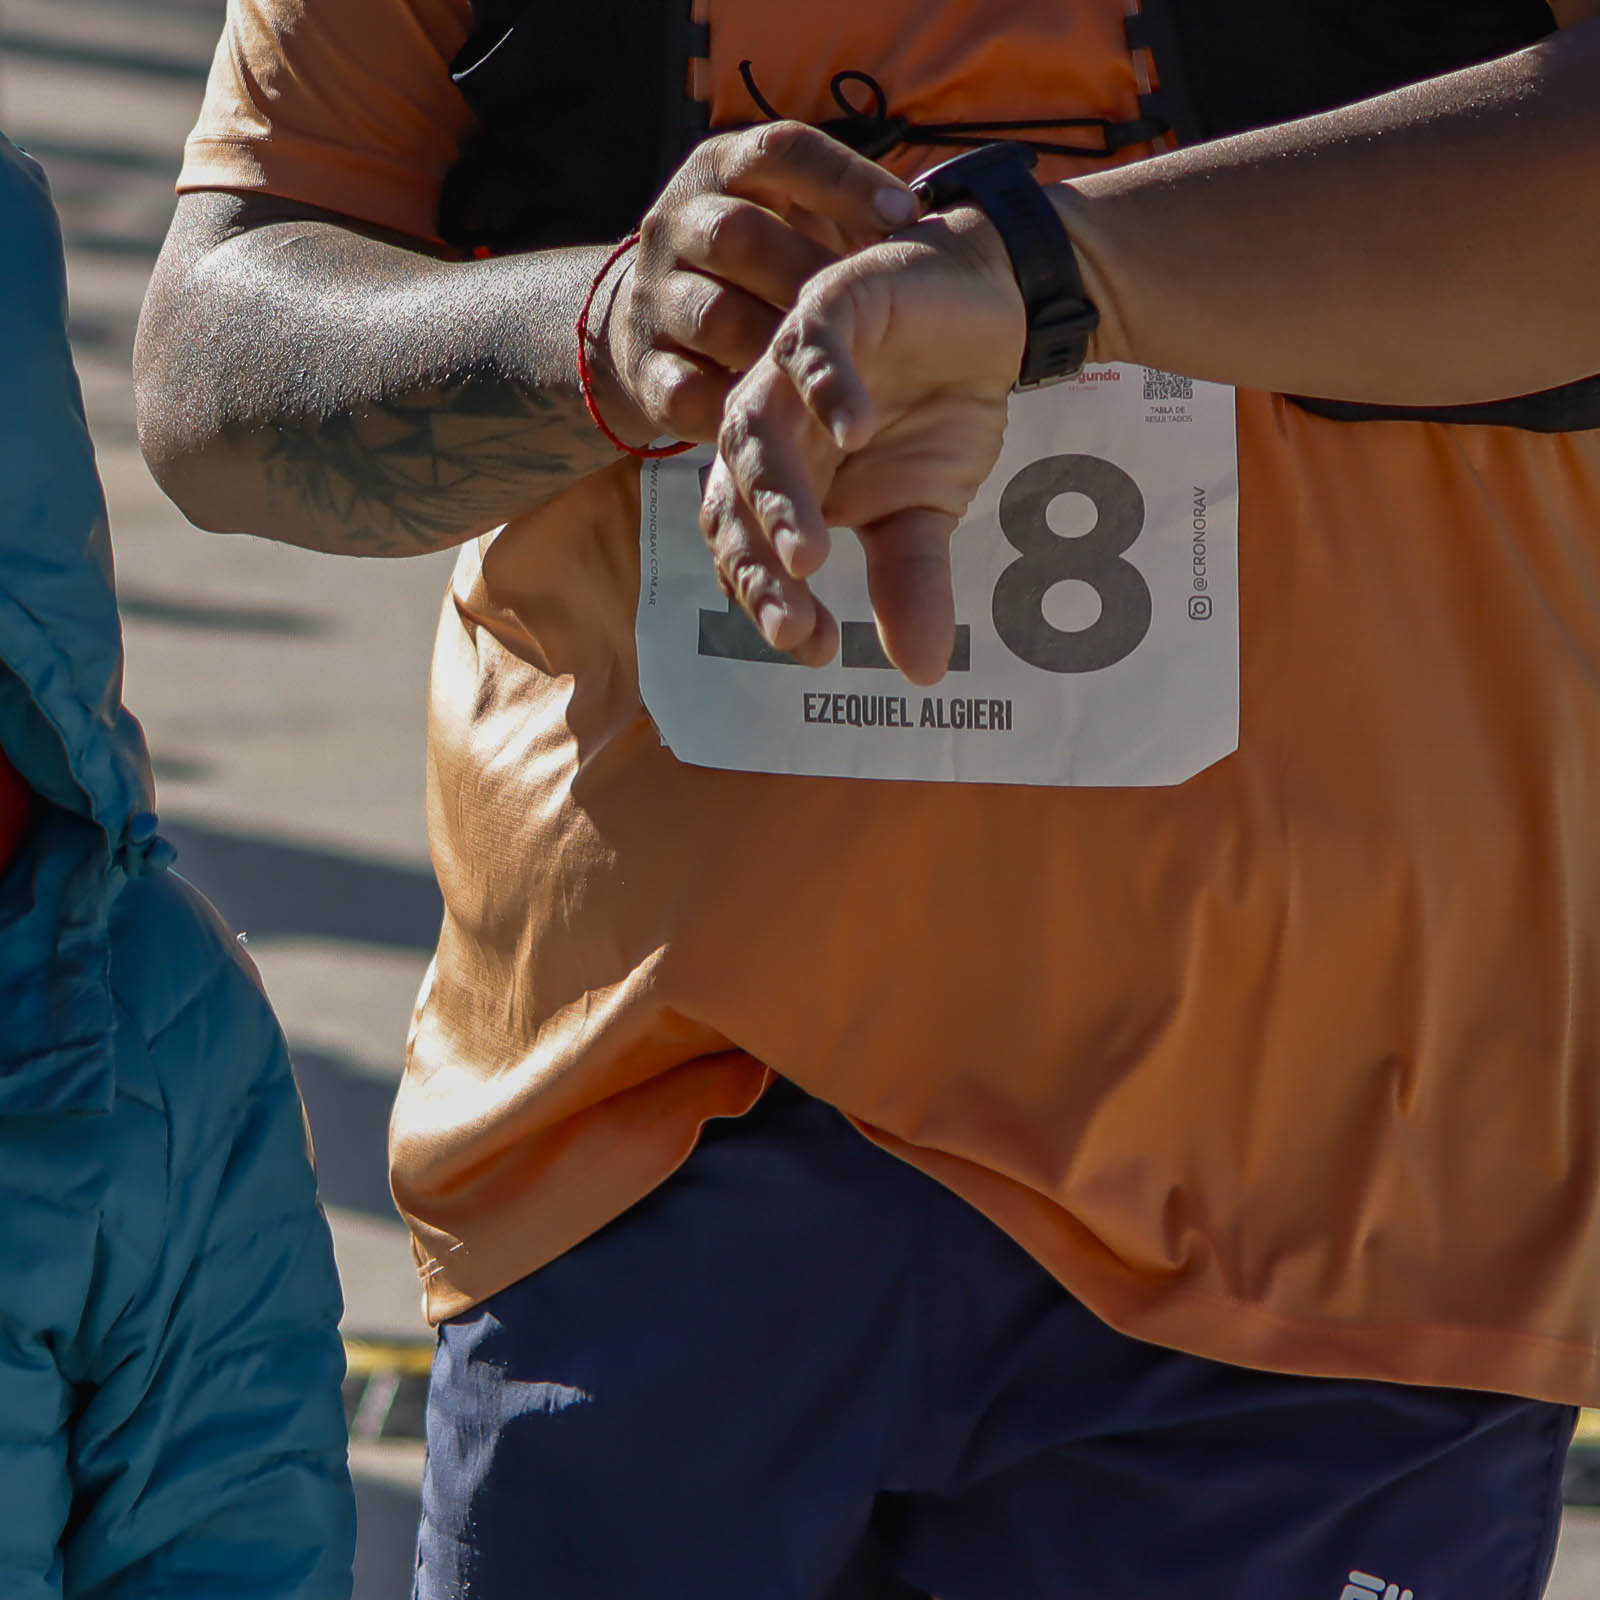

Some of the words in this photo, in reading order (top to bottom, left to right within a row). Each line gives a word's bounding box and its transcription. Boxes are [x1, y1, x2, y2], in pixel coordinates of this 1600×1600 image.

[1144, 414, 1193, 423] RESULTADOS
[1150, 406, 1174, 414] TABLA
[1176, 406, 1185, 414] DE
[1192, 485, 1208, 592] @CRONORAV
[803, 692, 914, 728] EZEQUIEL
[919, 697, 1013, 731] ALGIERI
